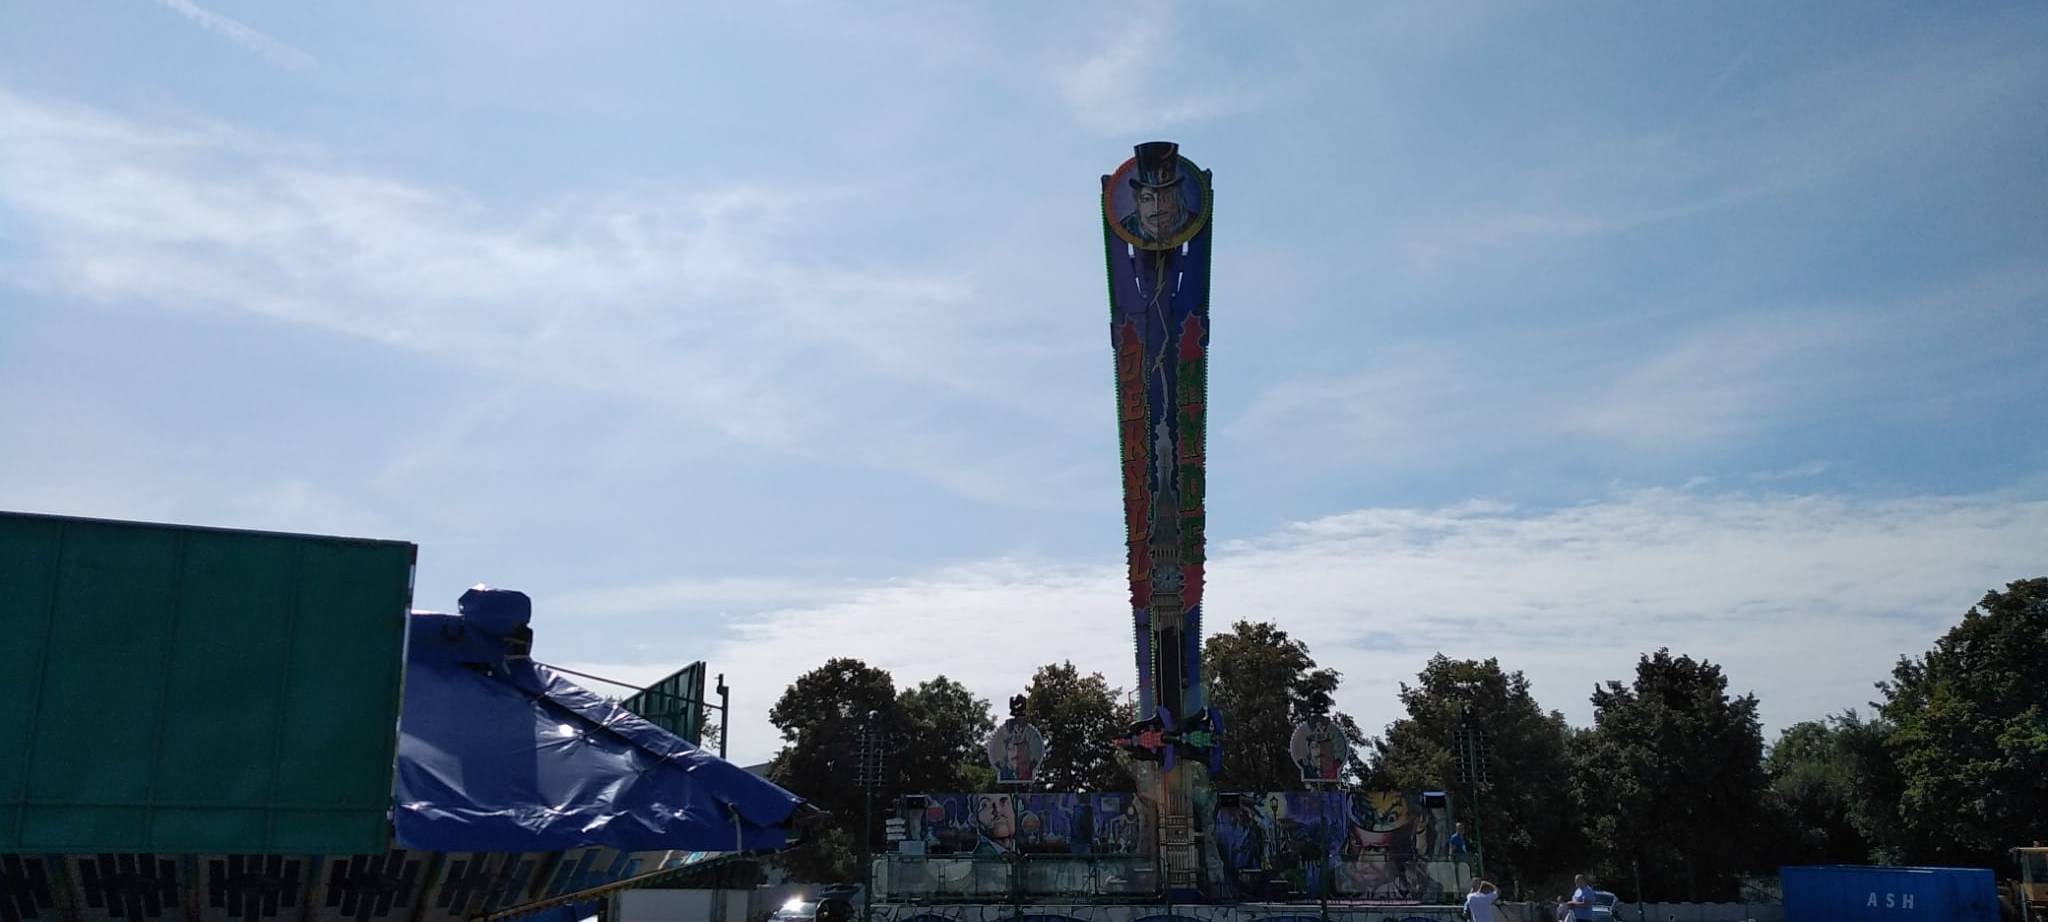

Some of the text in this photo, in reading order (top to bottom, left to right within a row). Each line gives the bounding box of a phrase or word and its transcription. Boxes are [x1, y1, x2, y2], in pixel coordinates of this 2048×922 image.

[1119, 342, 1150, 582] JEKYLL
[1178, 357, 1204, 565] HYDE
[1866, 892, 1915, 909] ASH
